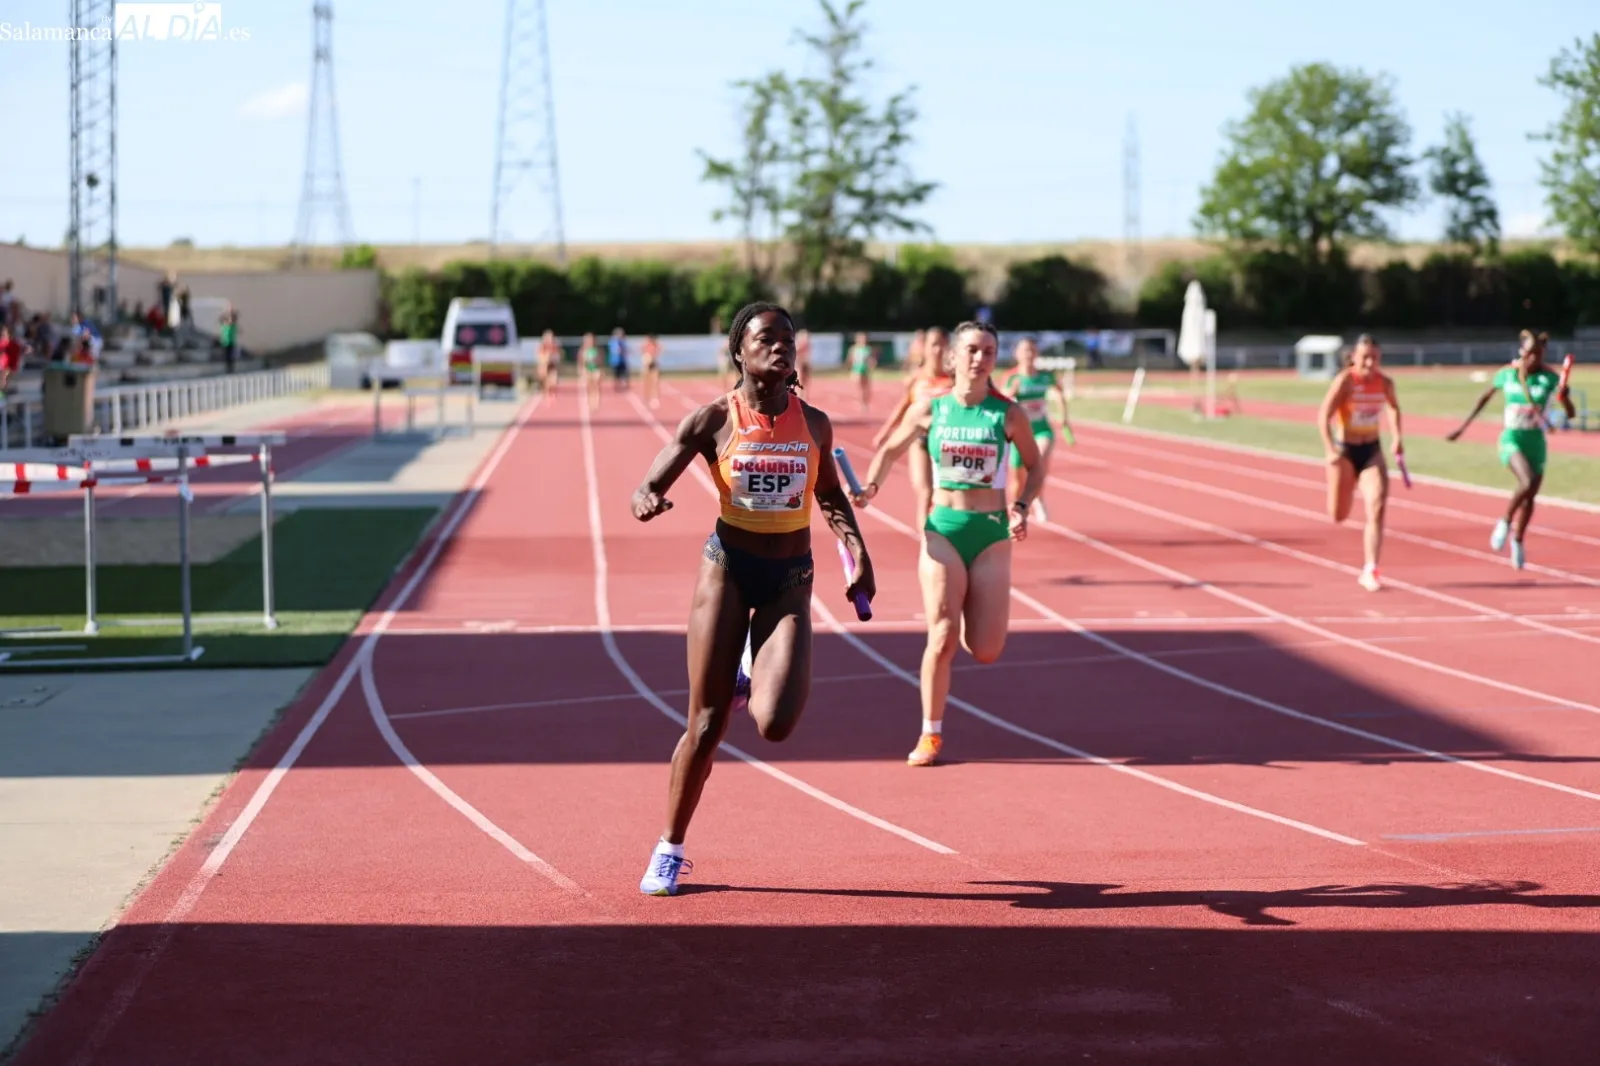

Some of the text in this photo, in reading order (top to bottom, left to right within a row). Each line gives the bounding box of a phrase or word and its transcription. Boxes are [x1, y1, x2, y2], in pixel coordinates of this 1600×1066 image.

[935, 425, 998, 440] PORTUGAL
[736, 440, 810, 452] ESPAÑA
[732, 459, 806, 474] bedunia
[952, 455, 985, 470] POR
[748, 474, 791, 493] ESP
